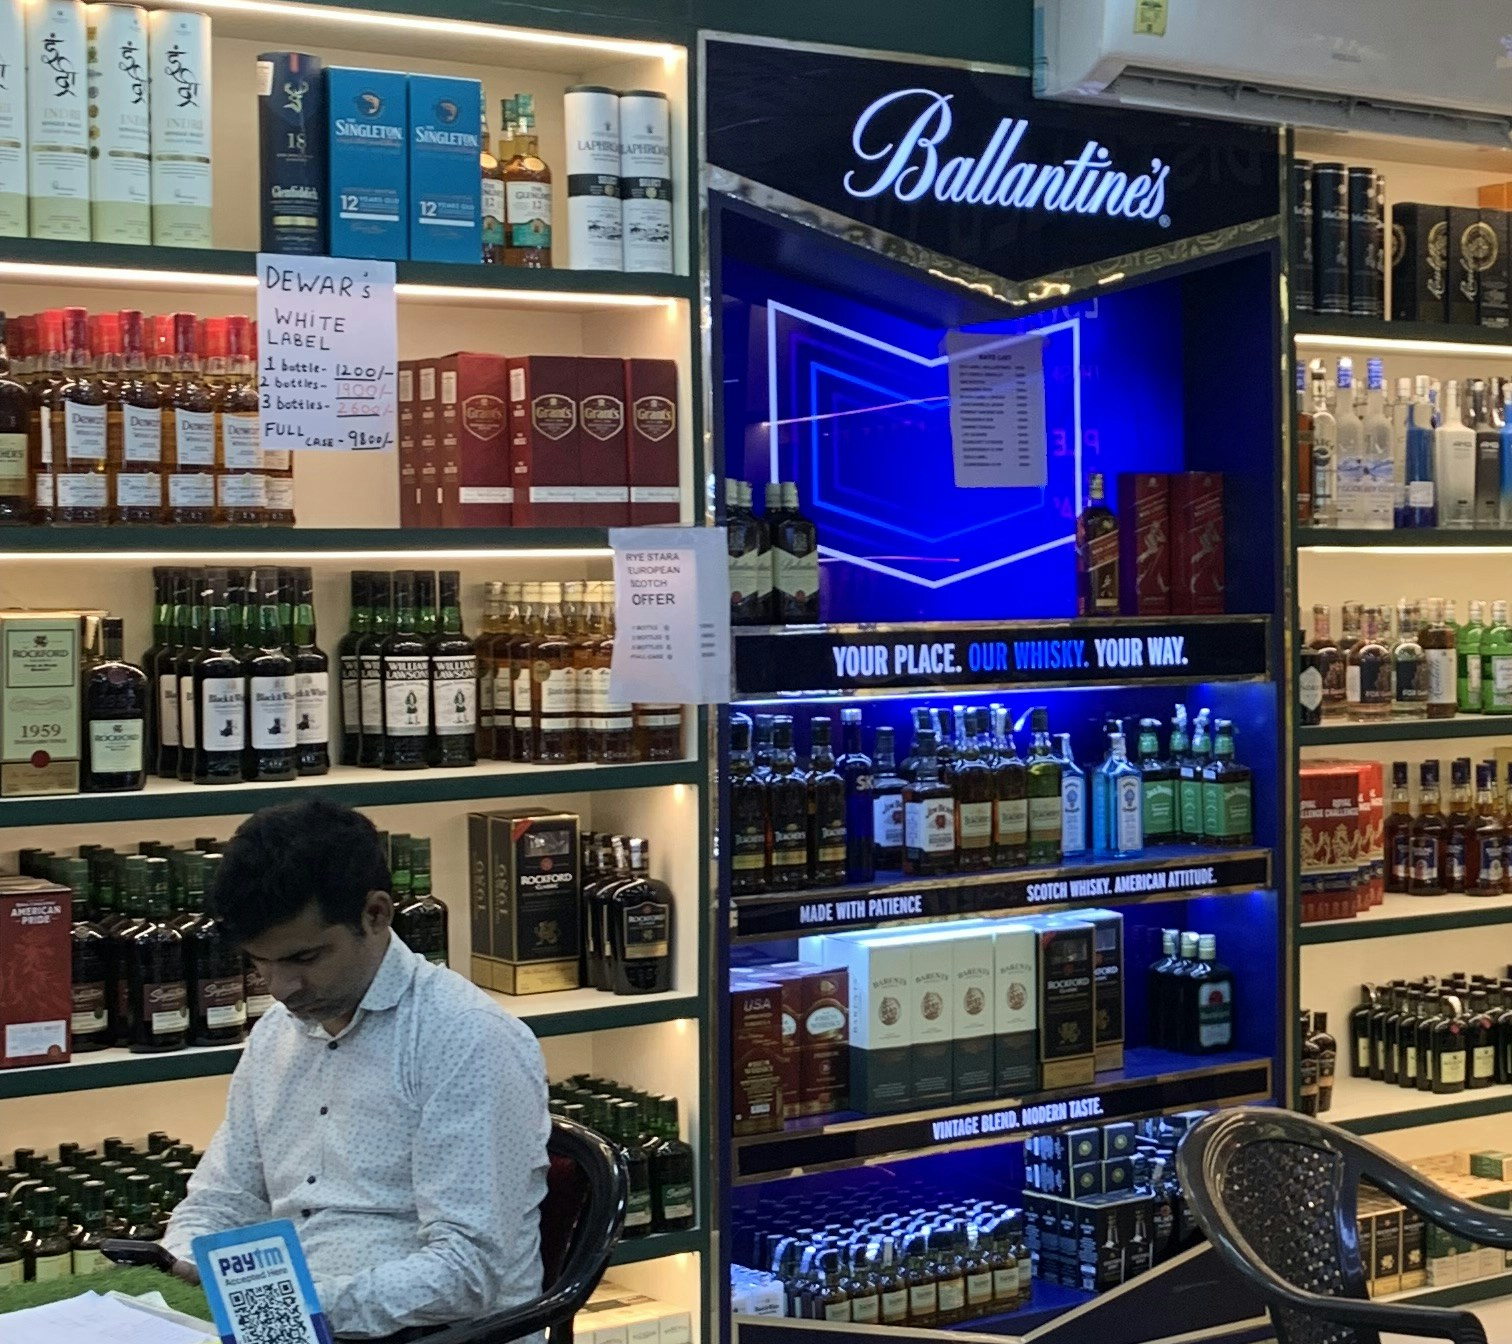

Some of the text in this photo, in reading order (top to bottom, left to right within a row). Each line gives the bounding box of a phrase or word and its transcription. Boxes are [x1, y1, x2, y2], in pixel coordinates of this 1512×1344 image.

[287, 132, 307, 150] 18
[842, 88, 1171, 221] Ballantine's
[339, 194, 360, 212] 12
[419, 201, 439, 217] 12
[267, 329, 331, 351] LABEL
[260, 376, 271, 388] 2
[262, 394, 272, 409] 3
[264, 422, 305, 437] FULL
[626, 553, 645, 561] RYE
[627, 566, 681, 575] EUROPEAN
[630, 579, 668, 588] SCOTCH
[631, 593, 676, 606] OFFER
[832, 635, 1190, 678] YOUR PLACE. OUR WHISKY. YOUR WAY.
[21, 724, 62, 739] 1959
[520, 872, 573, 886] ROCKFORD
[1026, 866, 1218, 902] SCOTCH WHISKY. AMERICAN ATTITUDE.
[11, 905, 62, 918] AMERICAN
[800, 894, 923, 923] MADE WITH PATIENCE
[21, 914, 51, 925] PRIDE
[1047, 976, 1090, 990] ROCKFORD
[743, 998, 772, 1012] USA
[932, 1096, 1104, 1141] VINTAGE BLEND. MODERN TASTE.
[225, 1266, 289, 1287] Accepted Here
